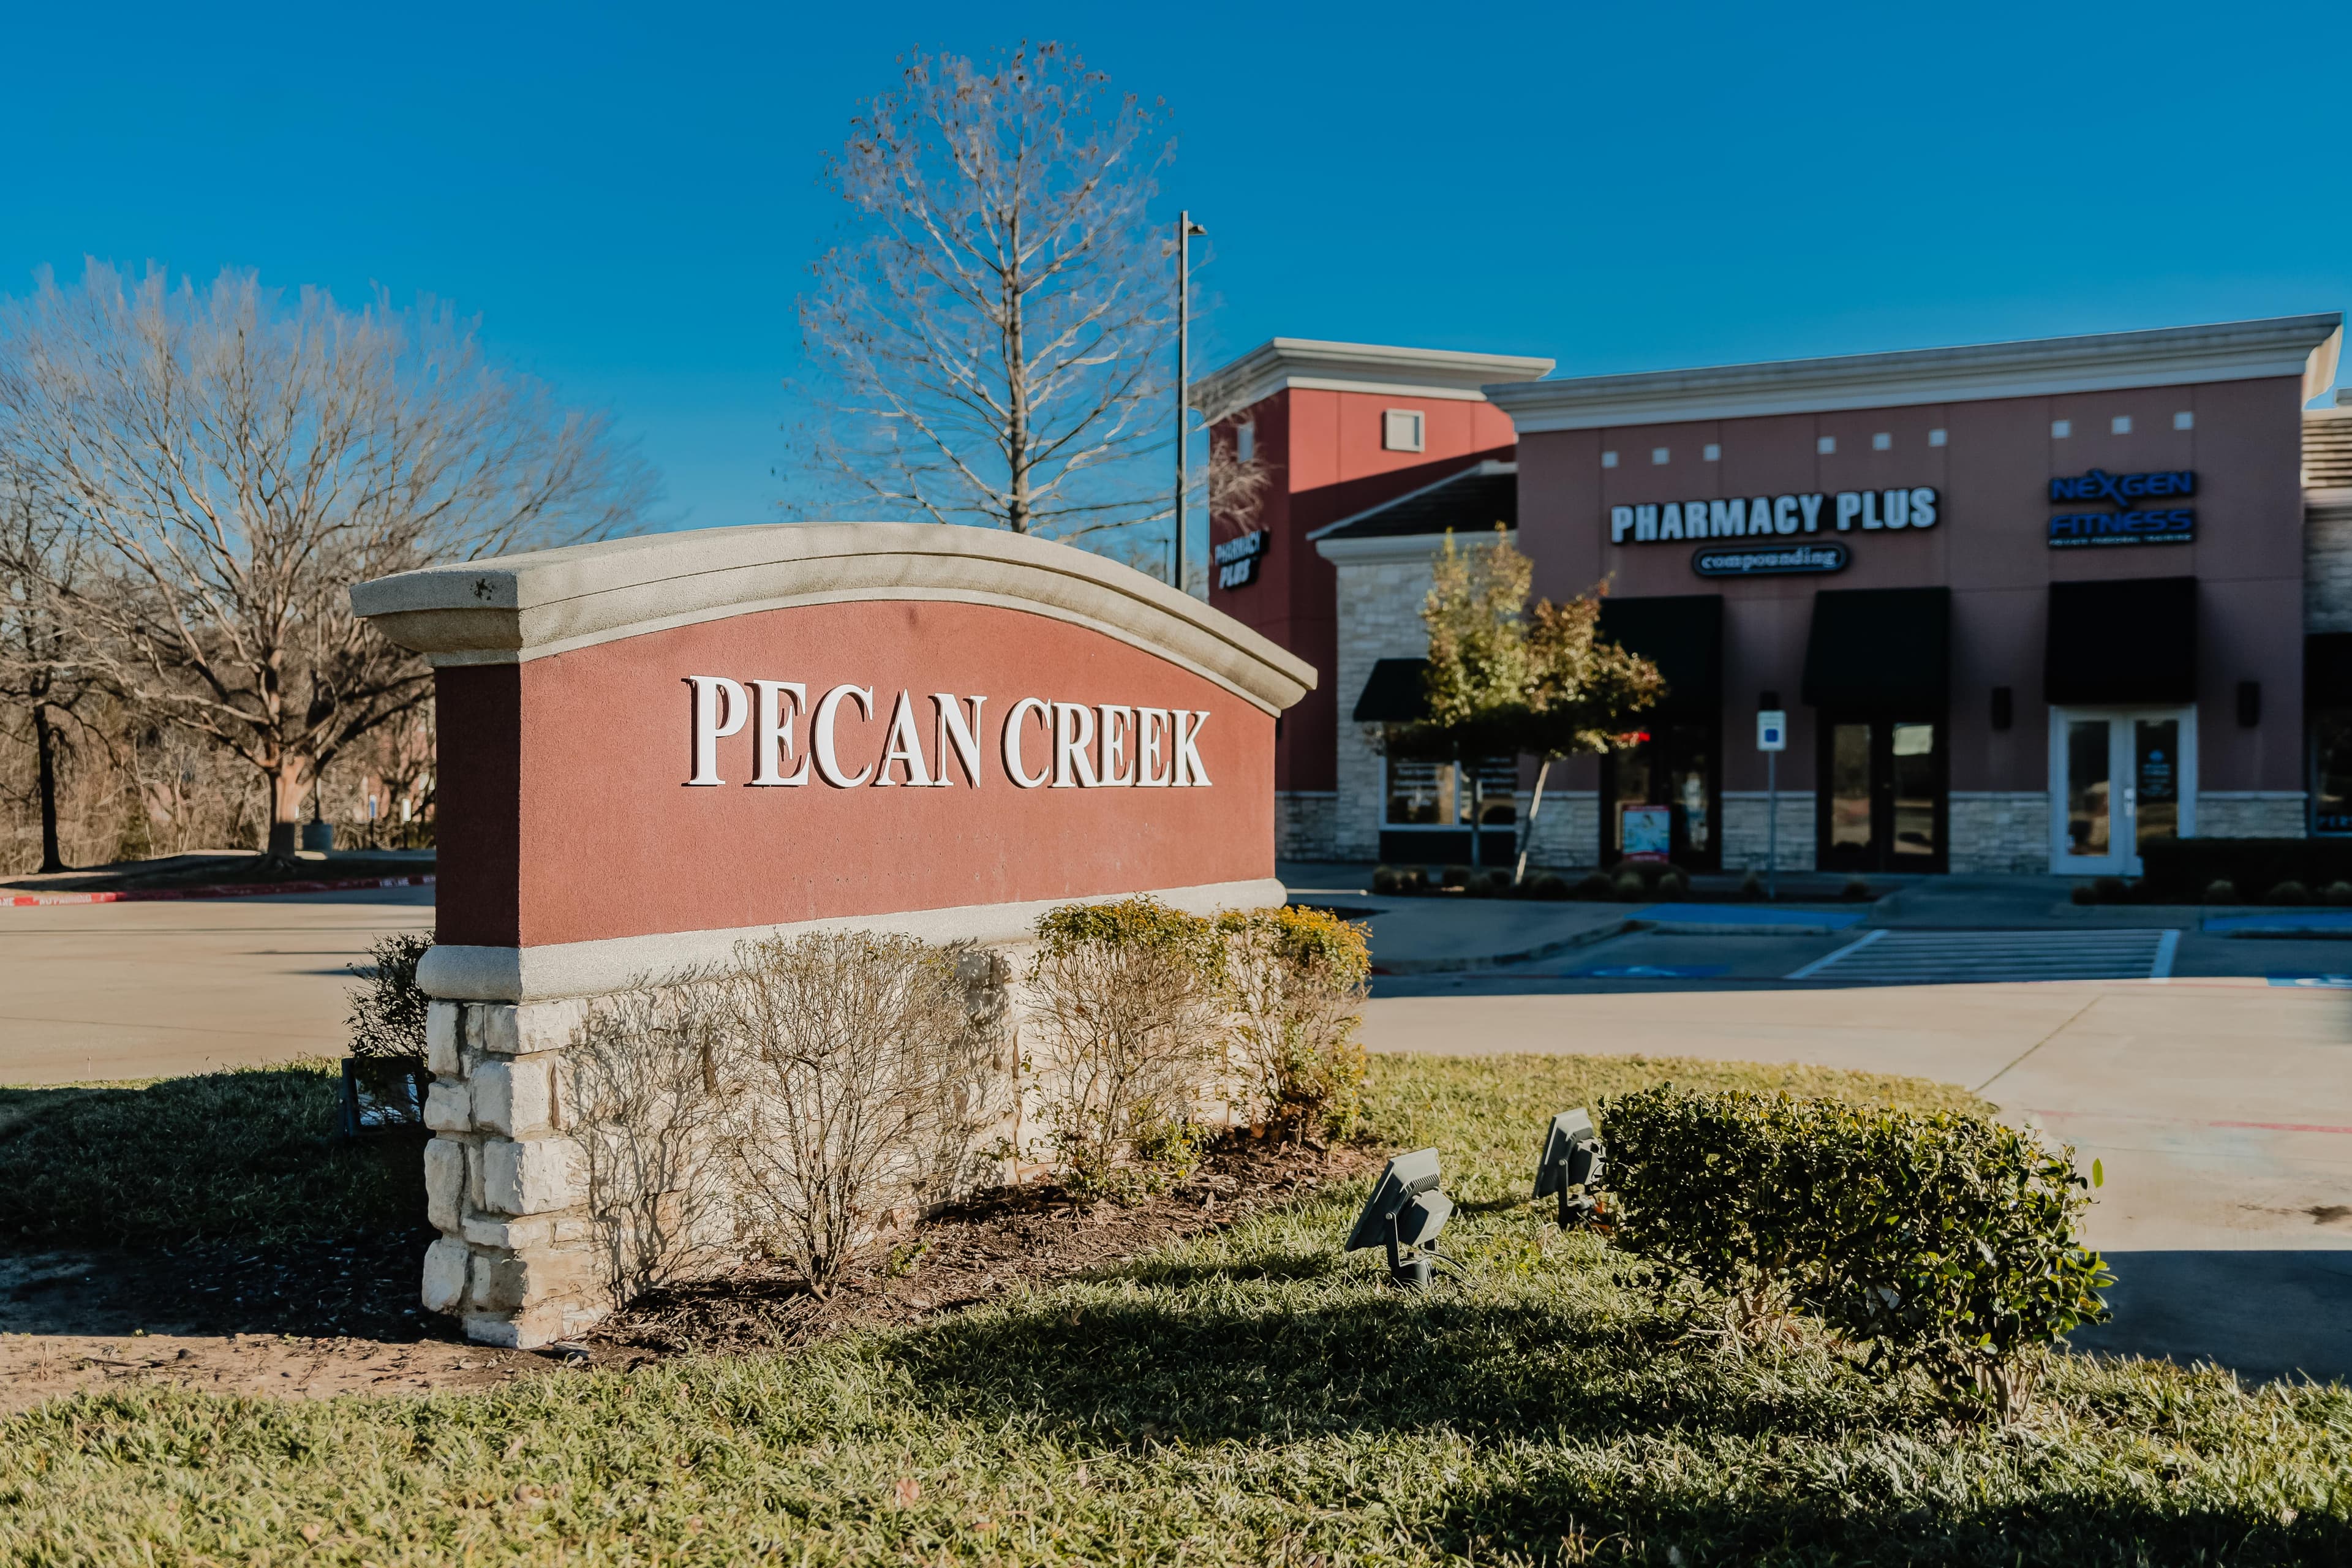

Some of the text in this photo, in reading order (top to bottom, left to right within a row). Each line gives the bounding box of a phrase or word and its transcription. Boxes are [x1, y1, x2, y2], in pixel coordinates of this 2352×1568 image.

[2051, 469, 2193, 507] NEXGEN
[1611, 487, 1937, 543] PHARMACY PLUS
[2051, 509, 2193, 535] FITNESS
[1700, 548, 1838, 571] compounding
[687, 675, 1213, 788] PECAN CREEK
